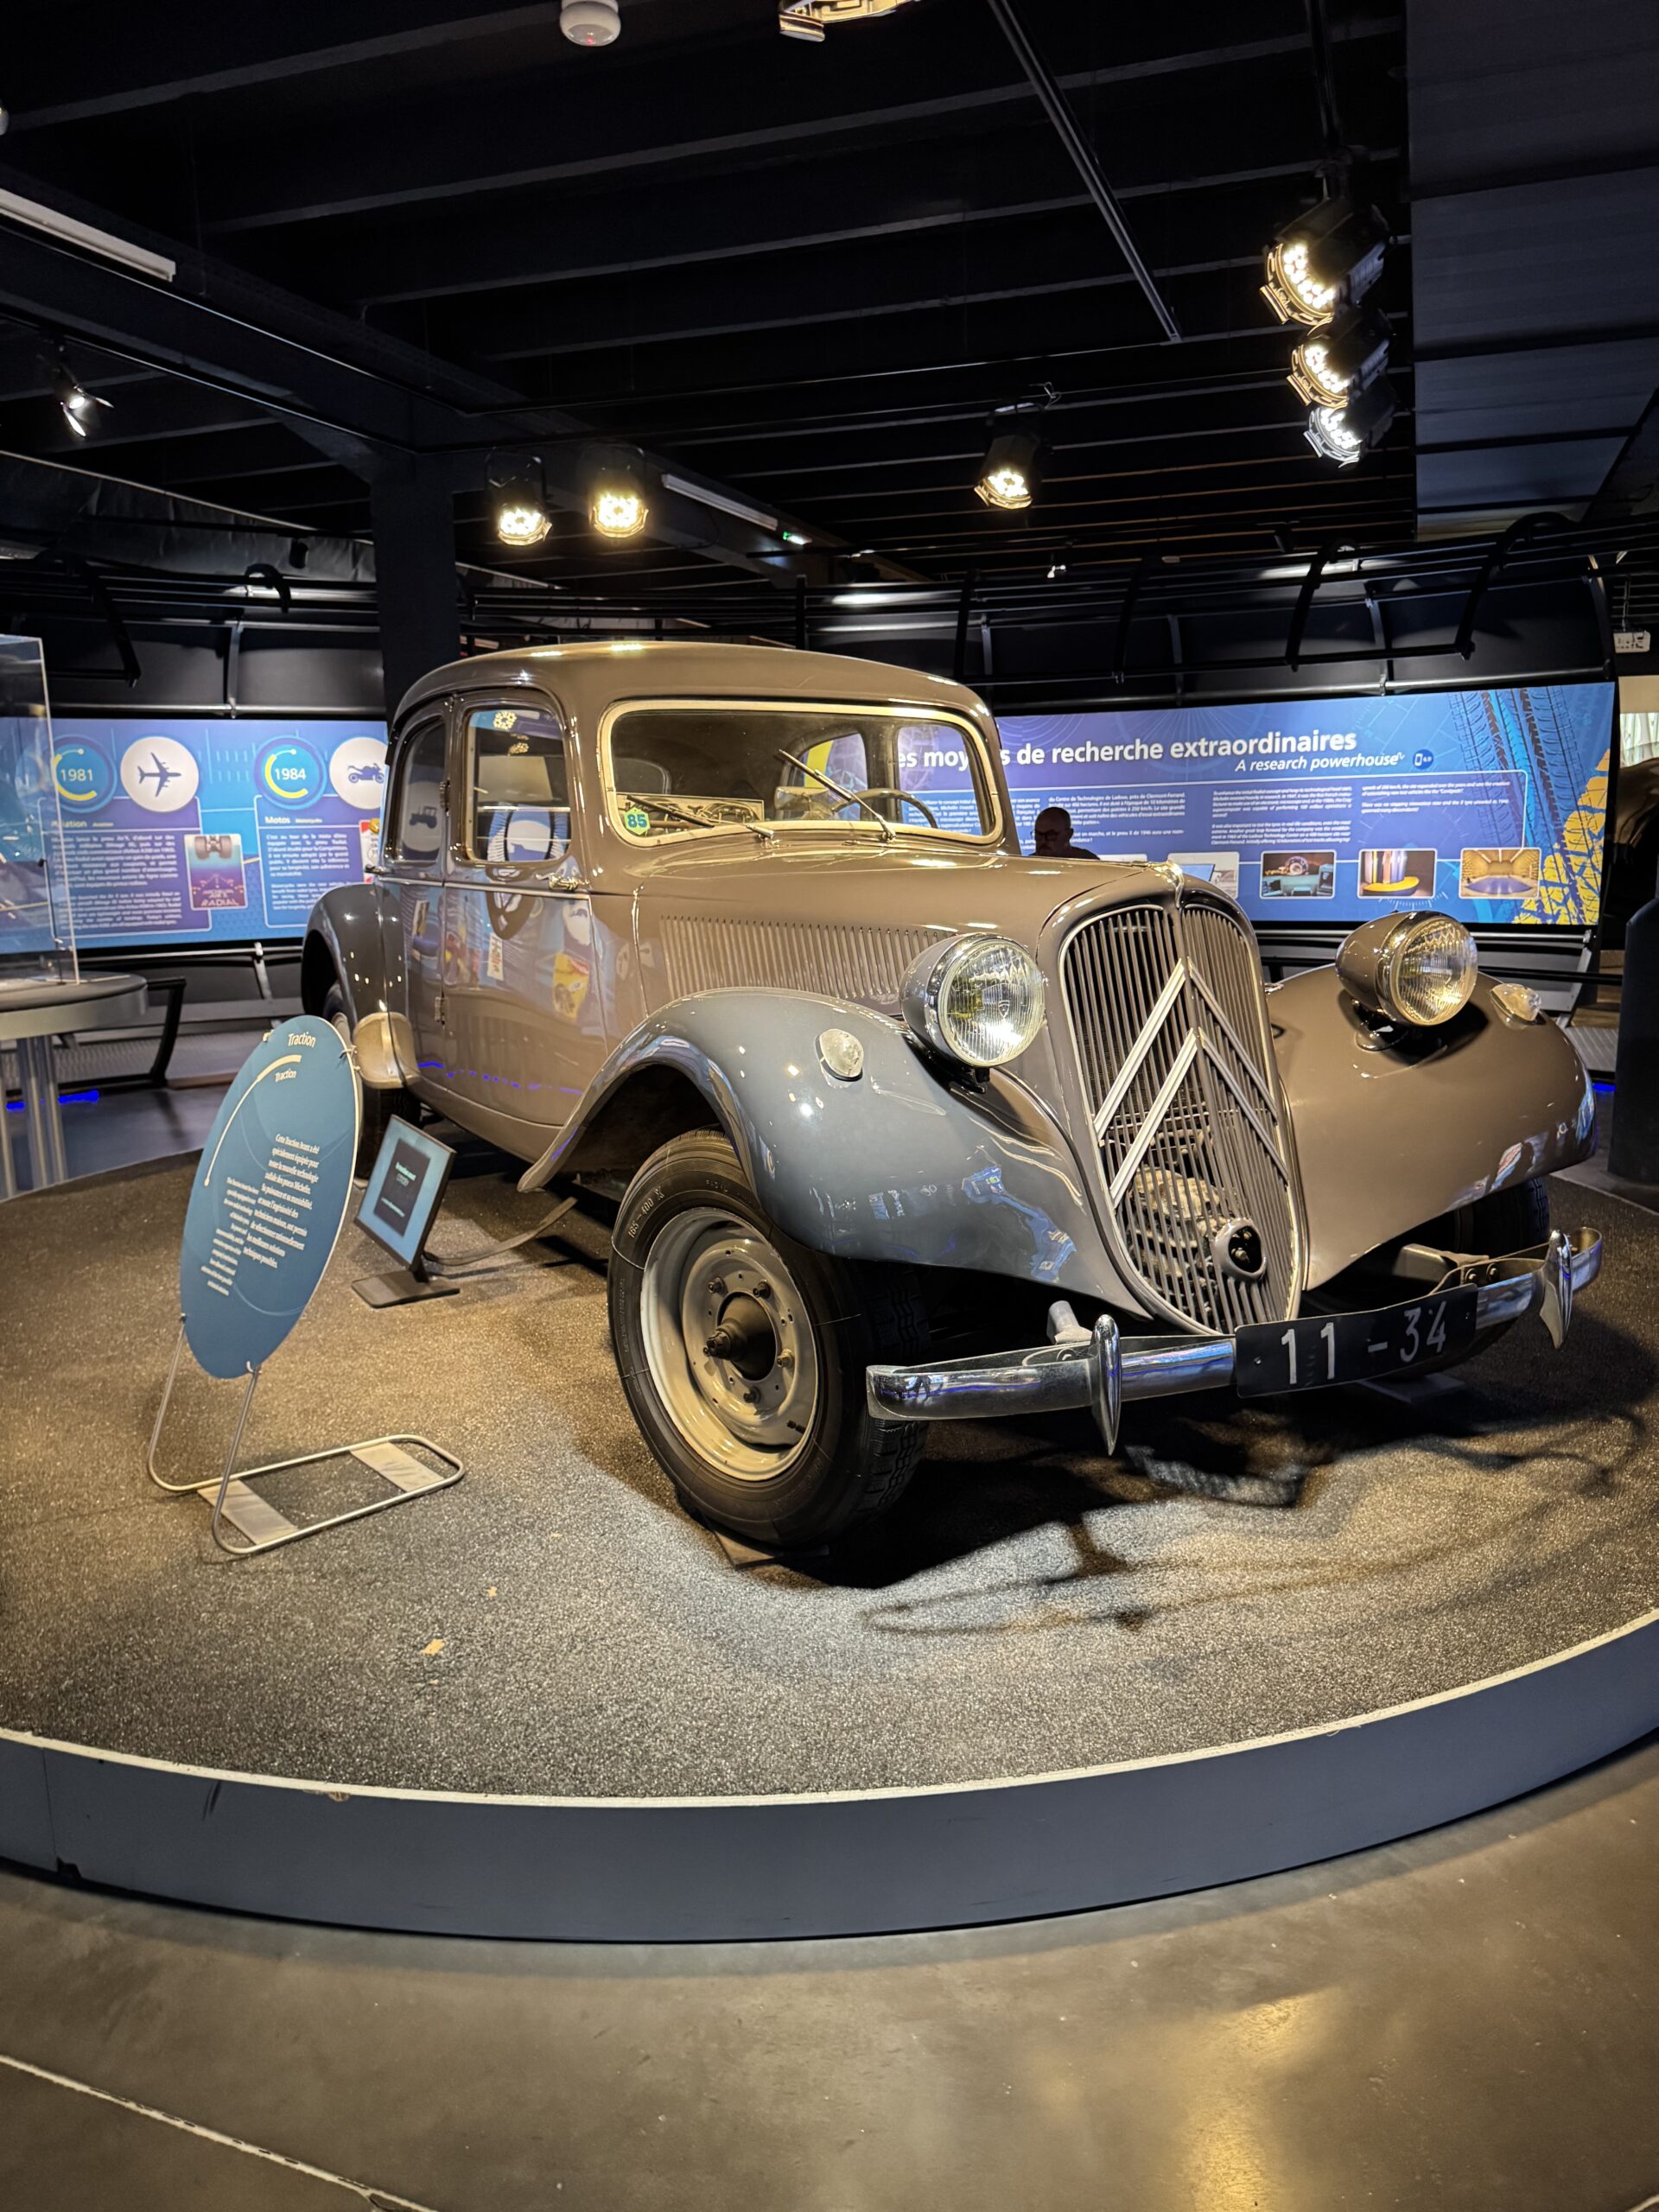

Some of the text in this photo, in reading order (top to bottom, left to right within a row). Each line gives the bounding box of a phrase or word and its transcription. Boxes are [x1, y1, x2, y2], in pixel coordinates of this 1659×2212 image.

[898, 753, 918, 768] es
[1016, 743, 1046, 766] de
[1052, 738, 1163, 764] recherche
[1170, 729, 1357, 760] extraordinaires
[1234, 753, 1399, 772] A research powerhouse
[60, 769, 94, 782] 1981
[274, 767, 308, 781] 1984
[265, 816, 290, 824] Motos
[627, 814, 647, 828] 85
[288, 1031, 316, 1048] Traction
[275, 1068, 297, 1083] Traction
